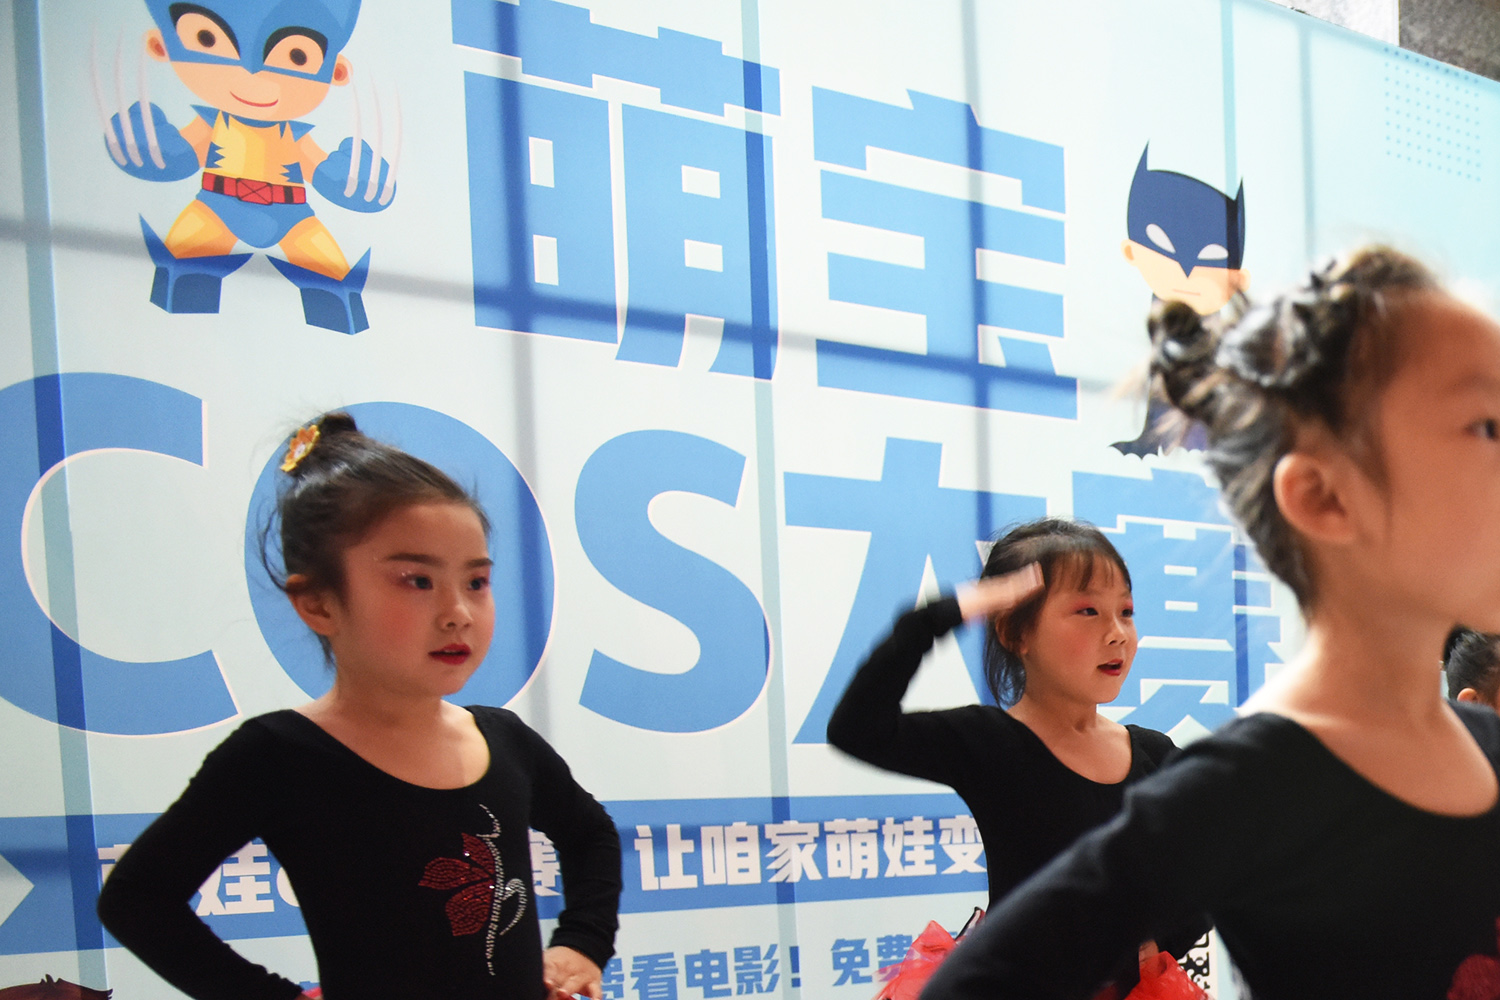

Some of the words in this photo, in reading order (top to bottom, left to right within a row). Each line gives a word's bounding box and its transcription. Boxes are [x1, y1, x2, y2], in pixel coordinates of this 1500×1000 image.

[450, 0, 1079, 421] 萌宝
[634, 815, 988, 891] 让咱家萌娃变
